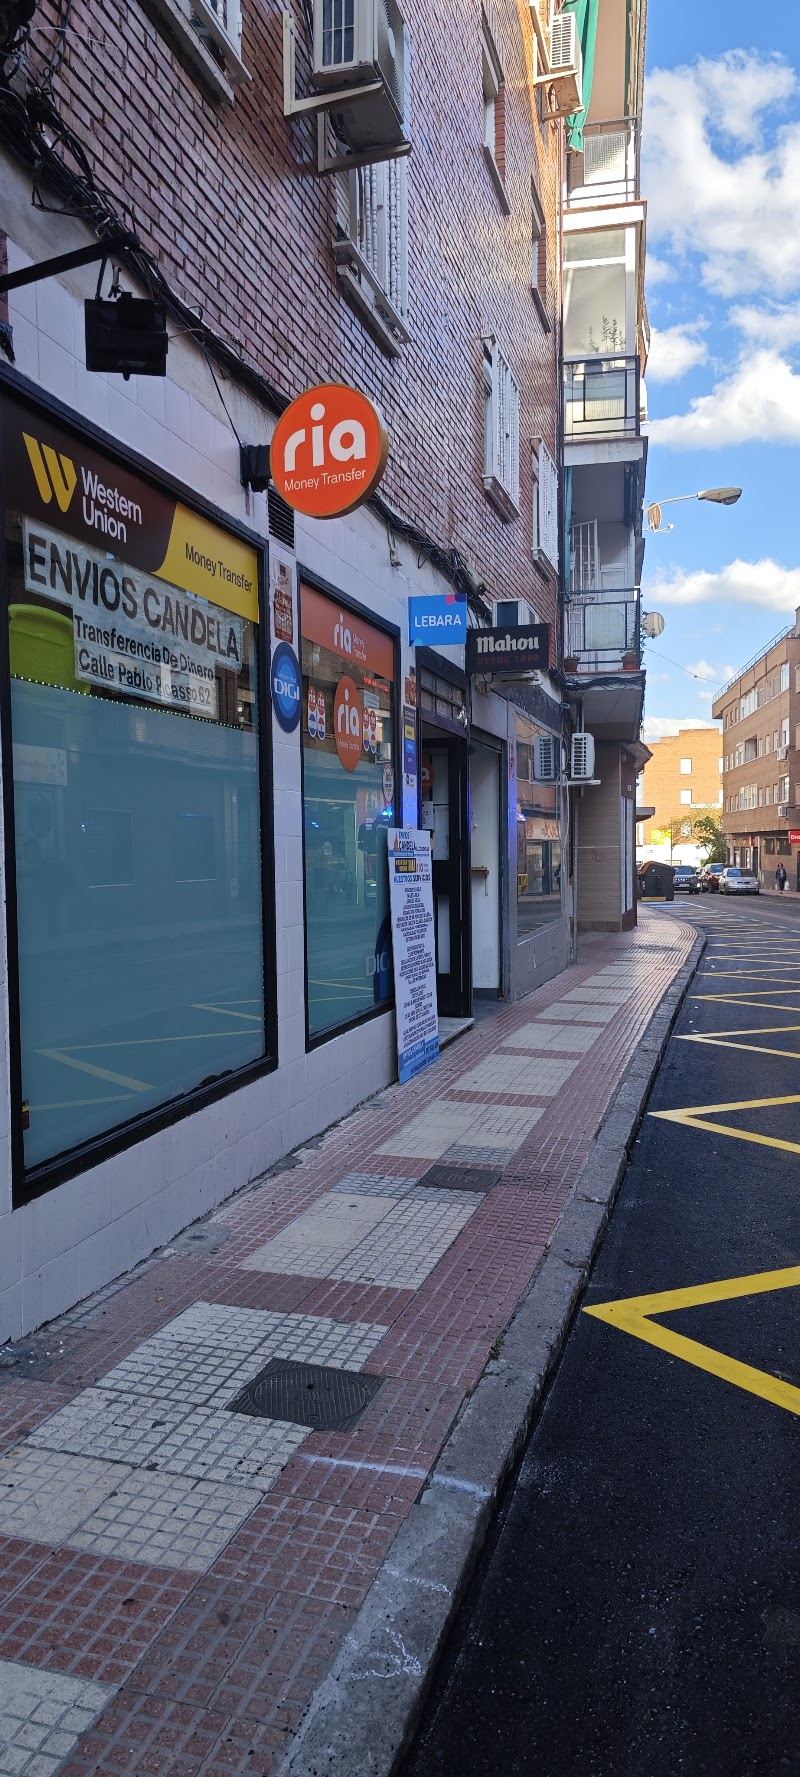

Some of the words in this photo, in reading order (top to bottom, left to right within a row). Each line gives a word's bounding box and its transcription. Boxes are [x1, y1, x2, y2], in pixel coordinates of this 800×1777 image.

[283, 403, 366, 473] ria
[81, 466, 142, 525] Western
[284, 477, 319, 491] Money
[321, 468, 367, 485] Transfer
[82, 496, 127, 543] Union
[185, 542, 217, 576] Money
[217, 560, 253, 592] Transfer
[28, 533, 138, 619] ENVIOS
[143, 588, 240, 662] CANDELA
[414, 614, 462, 628] LEBARA
[74, 614, 161, 663] Transferencia
[162, 646, 179, 668] De
[179, 656, 214, 682] Dinero
[333, 612, 352, 654] ria
[476, 634, 540, 654] Mahou
[78, 649, 115, 679] Calle
[118, 662, 153, 690] Pablo
[155, 676, 198, 702] Picasso
[273, 677, 300, 701] DIGI
[337, 688, 360, 737] ria
[365, 951, 390, 977] DIG
